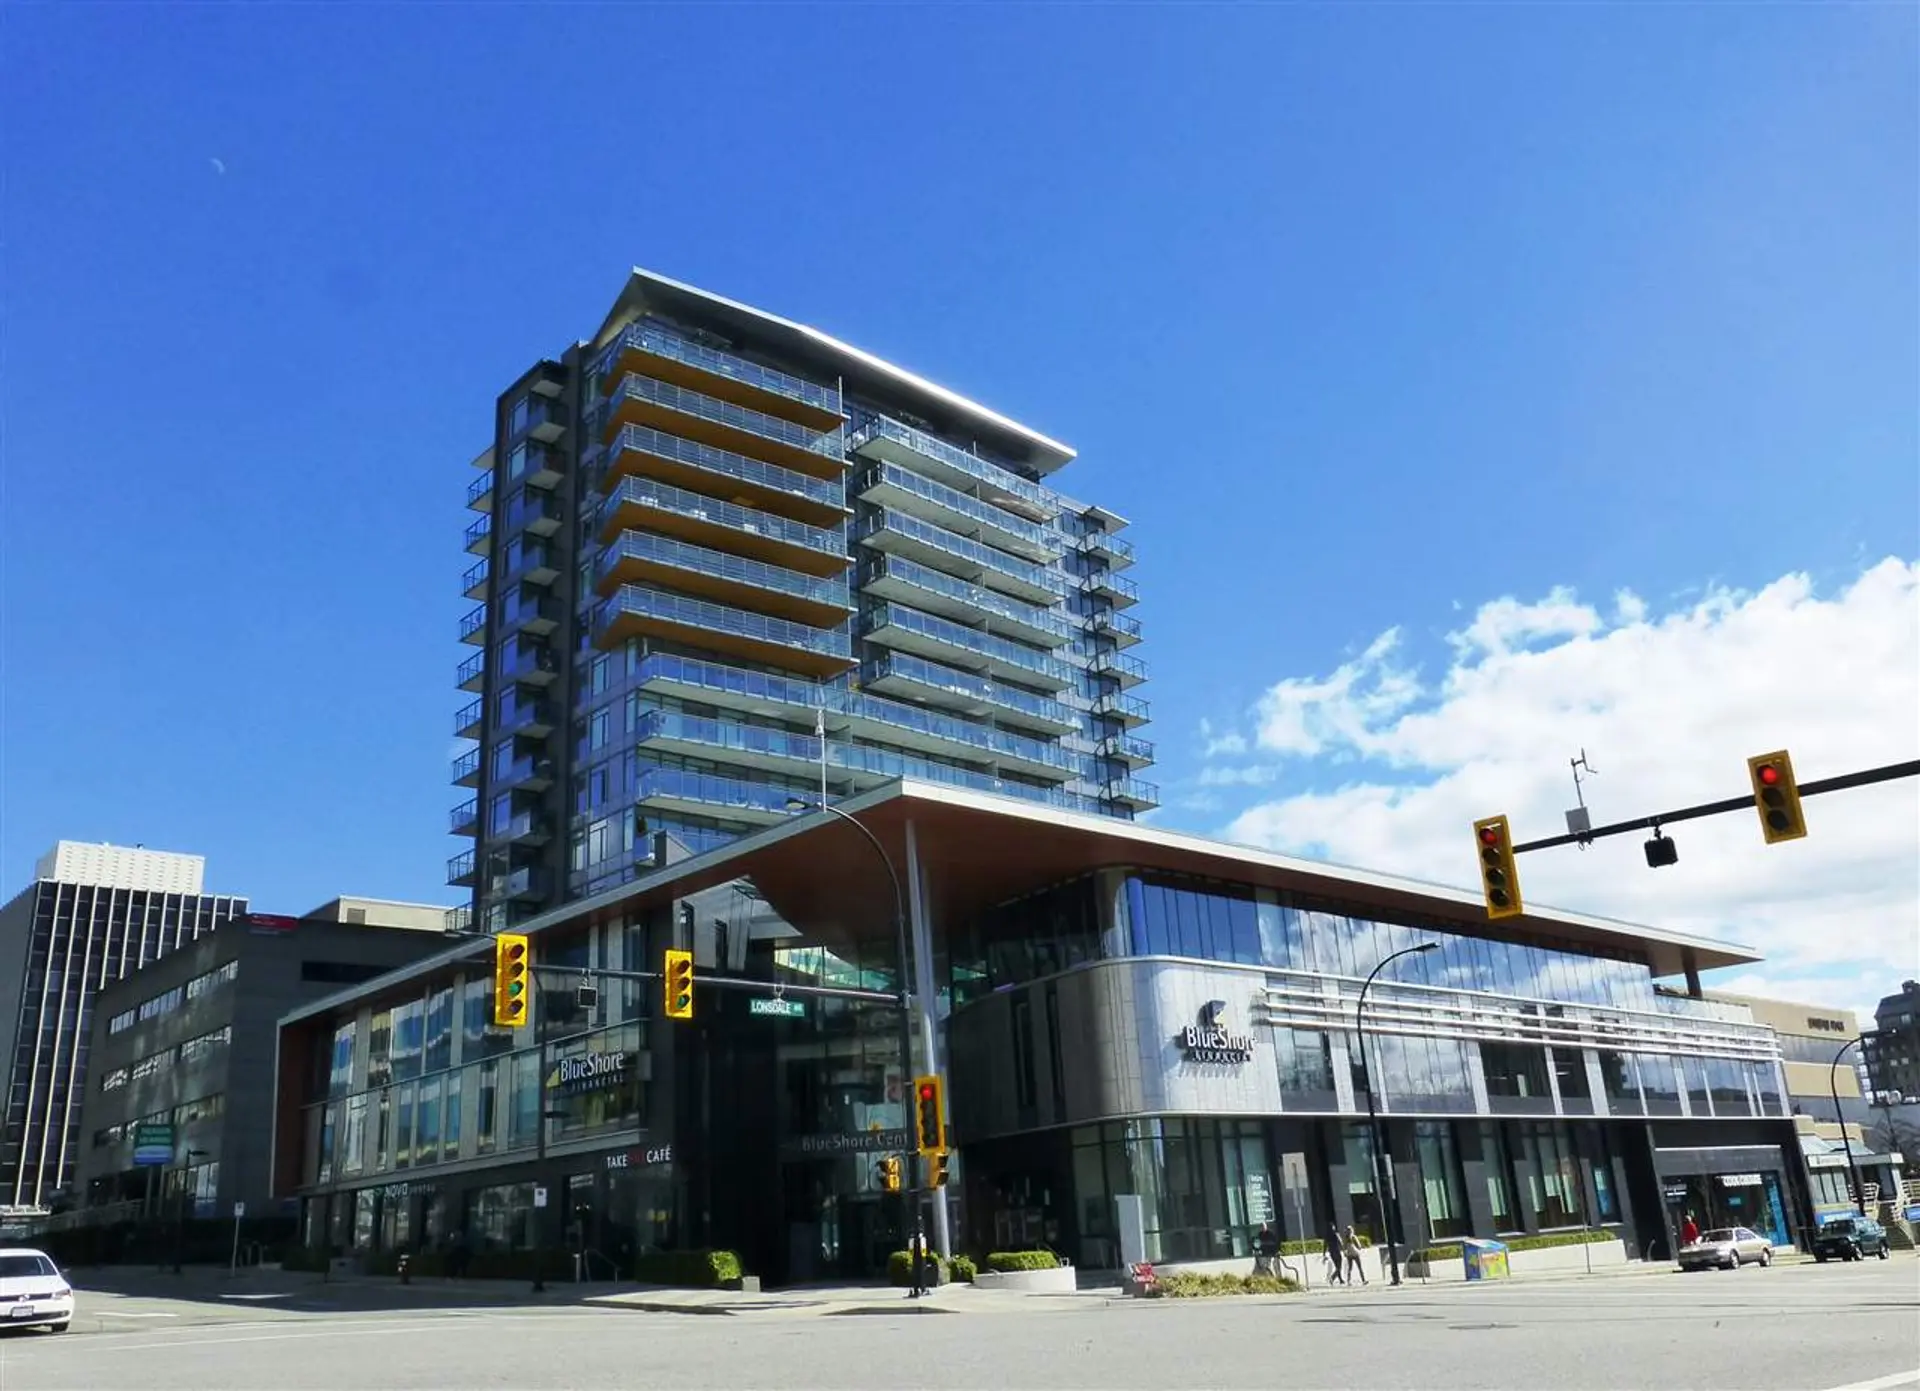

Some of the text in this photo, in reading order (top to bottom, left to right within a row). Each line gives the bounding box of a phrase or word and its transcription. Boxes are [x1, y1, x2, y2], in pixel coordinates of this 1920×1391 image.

[751, 999, 791, 1015] LONSDALE
[1186, 1026, 1256, 1051] BlueShor
[560, 1052, 624, 1082] BlueShore
[802, 1133, 872, 1152] BlueShore
[607, 1154, 628, 1169] TAKE
[646, 1144, 671, 1164] CAFÉ
